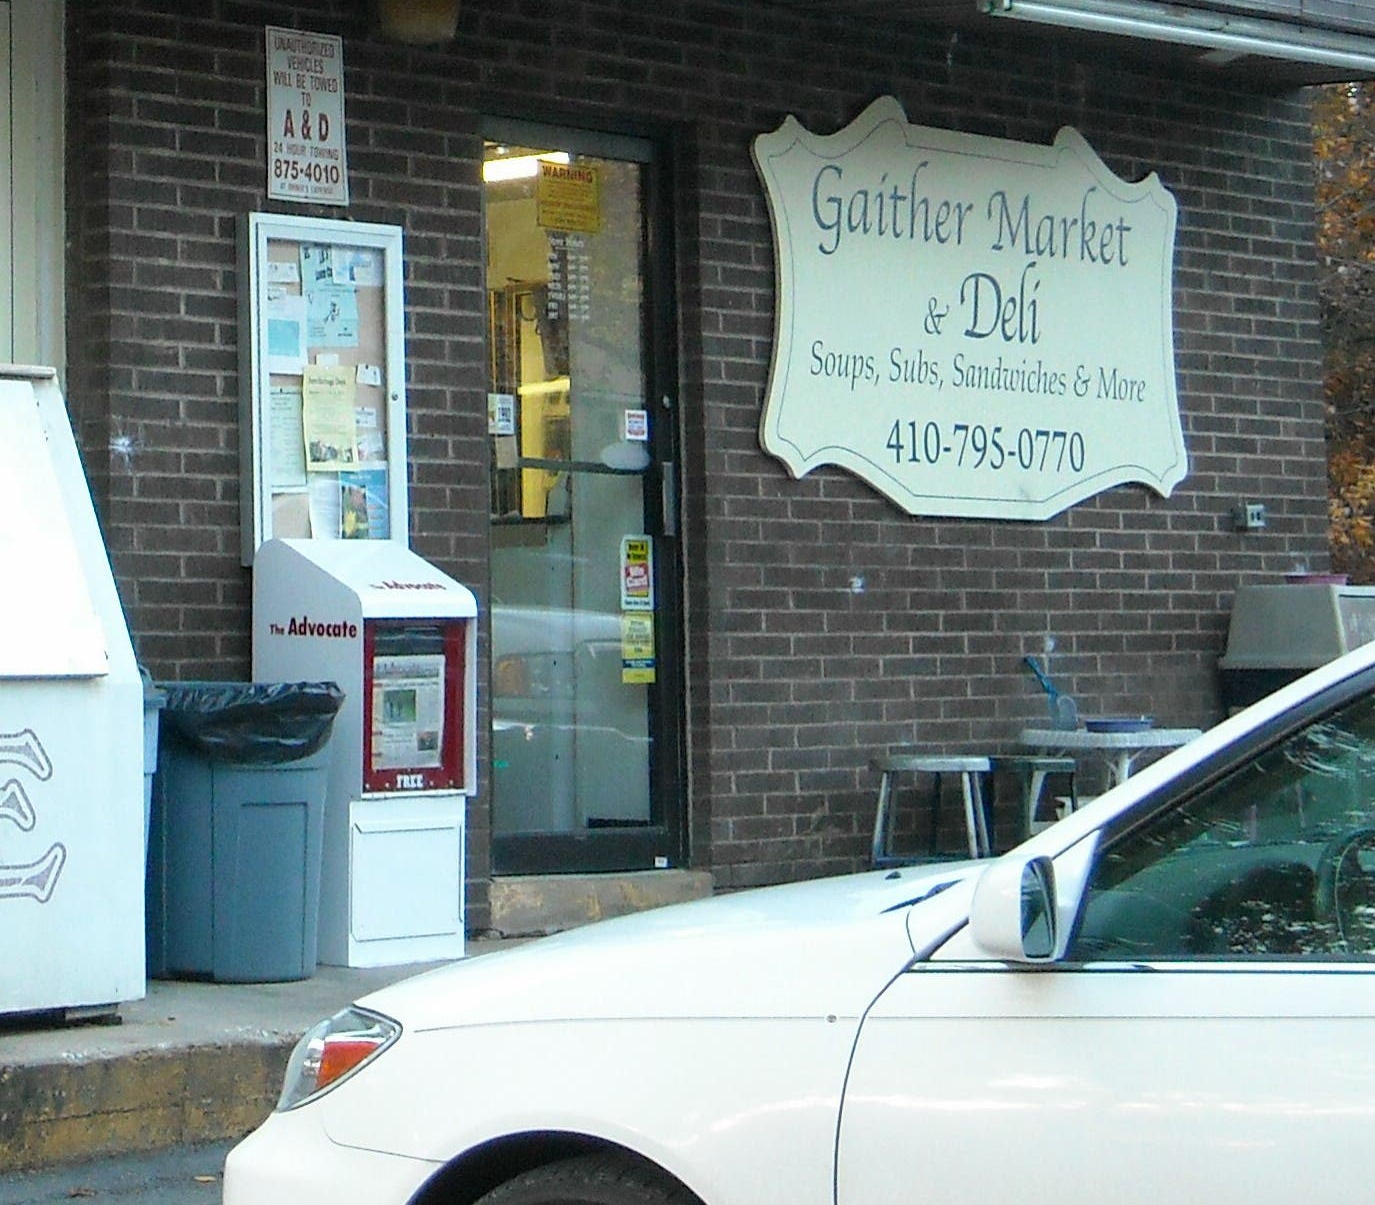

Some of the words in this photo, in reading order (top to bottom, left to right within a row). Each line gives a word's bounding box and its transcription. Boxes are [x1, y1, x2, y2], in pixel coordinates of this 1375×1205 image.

[287, 56, 324, 75] VEHICLES
[273, 70, 292, 88] WILL
[296, 74, 306, 89] BE
[310, 76, 338, 93] TOWED
[301, 91, 312, 108] TO
[283, 109, 294, 138] A
[301, 109, 312, 141] &
[318, 112, 329, 142] D
[273, 141, 283, 154] 24
[541, 165, 593, 183] WARNING
[811, 161, 974, 254] Gaither
[986, 186, 1132, 266] Market
[923, 297, 950, 335] &
[959, 261, 1041, 345] Deli
[810, 340, 881, 391] Soups,
[889, 347, 944, 390] Subs,
[952, 353, 1067, 396] Sandwiches
[1073, 364, 1091, 398] &
[1097, 367, 1146, 402] More
[886, 418, 1086, 473] 410-795-0770
[270, 624, 285, 635] The
[288, 615, 357, 638] Advocate
[396, 774, 424, 788] FREE
